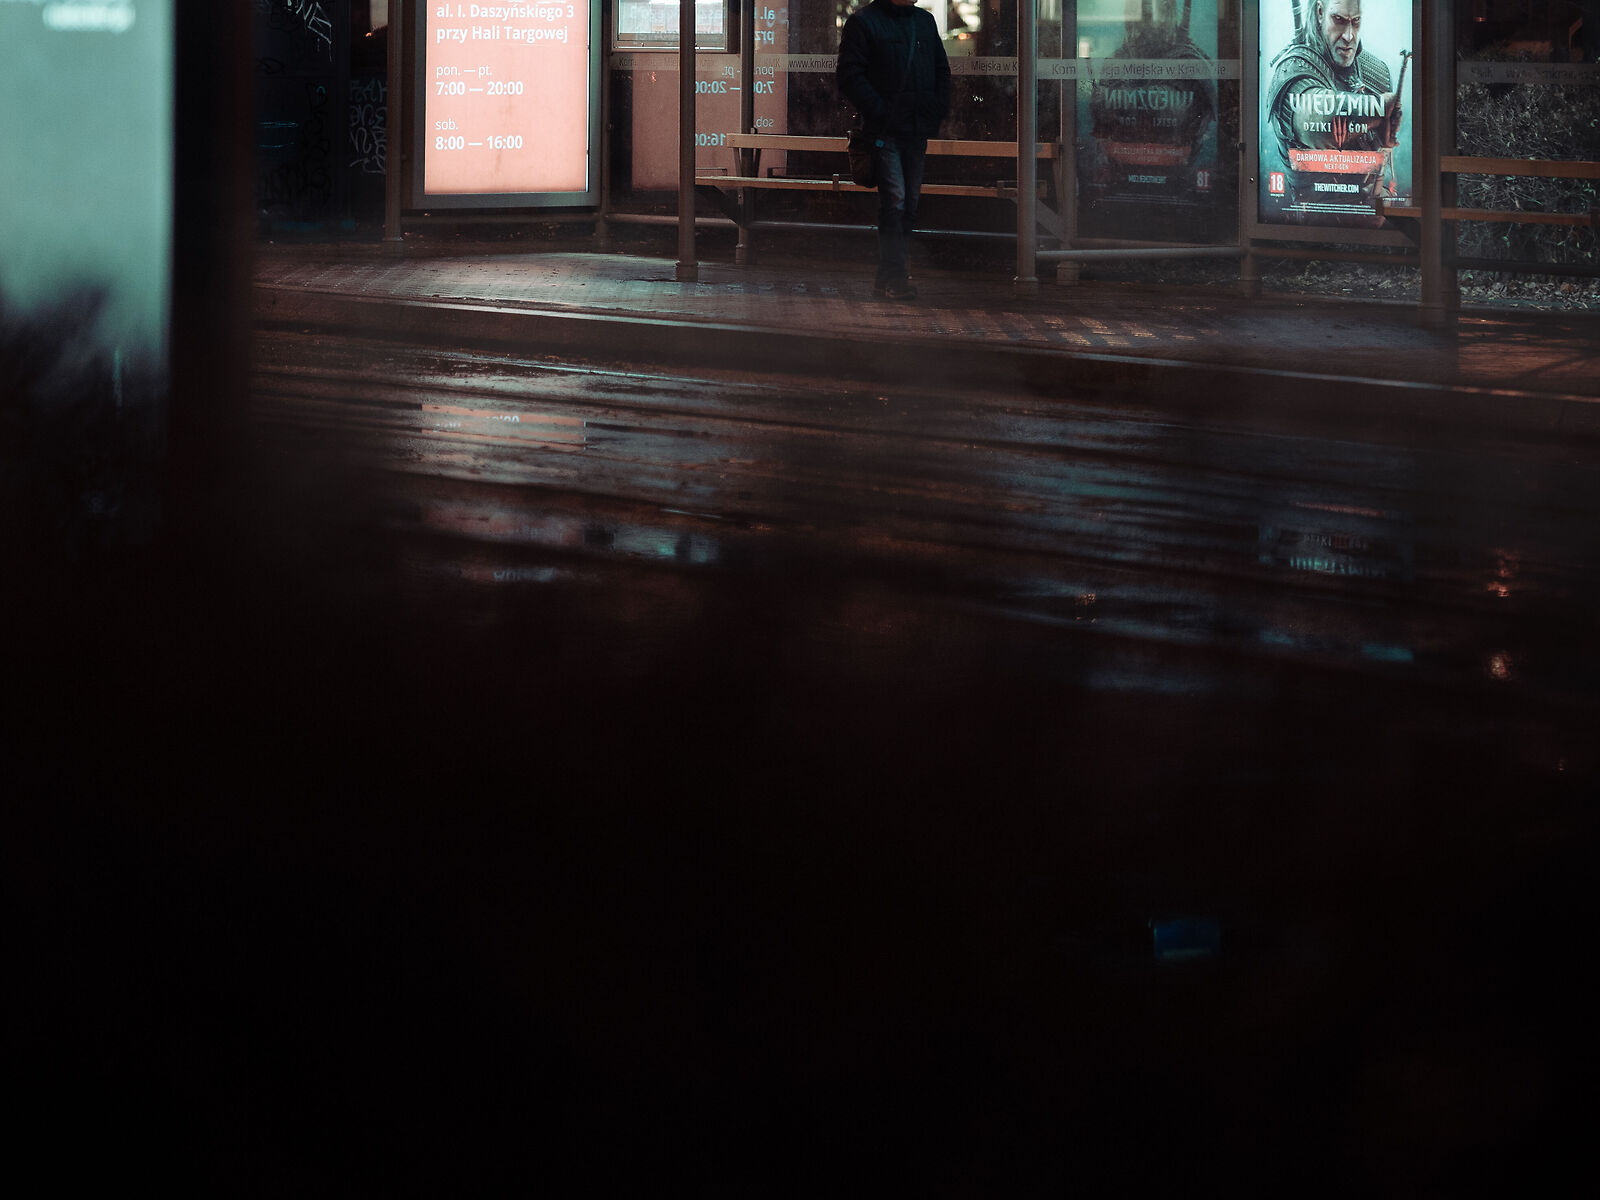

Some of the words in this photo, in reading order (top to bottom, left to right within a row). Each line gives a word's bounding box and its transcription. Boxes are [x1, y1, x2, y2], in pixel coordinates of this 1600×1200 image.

[436, 4, 453, 18] al.
[457, 4, 466, 18] I.
[470, 3, 563, 21] Daszyńskiego
[566, 4, 575, 18] 3
[436, 28, 469, 44] przy
[472, 25, 500, 40] Hali
[504, 26, 569, 44] Targowej
[788, 57, 837, 68] www.kmkrak
[436, 67, 461, 79] pon.
[478, 64, 493, 79] pt.
[1123, 63, 1163, 78] Miejska
[1165, 66, 1176, 75] w
[435, 81, 466, 96] 7:00
[487, 81, 524, 96] 20:00
[435, 118, 459, 131] sob.
[1303, 121, 1332, 133] DZIKI
[1348, 122, 1369, 134] GON
[435, 136, 465, 150] 8:00
[486, 135, 523, 150] 16:00
[1296, 153, 1328, 163] DARMOWA
[1329, 154, 1377, 165] AKTUALIZACJA
[1270, 174, 1284, 191] 18
[1314, 183, 1360, 194] THEWITCHER.COM
